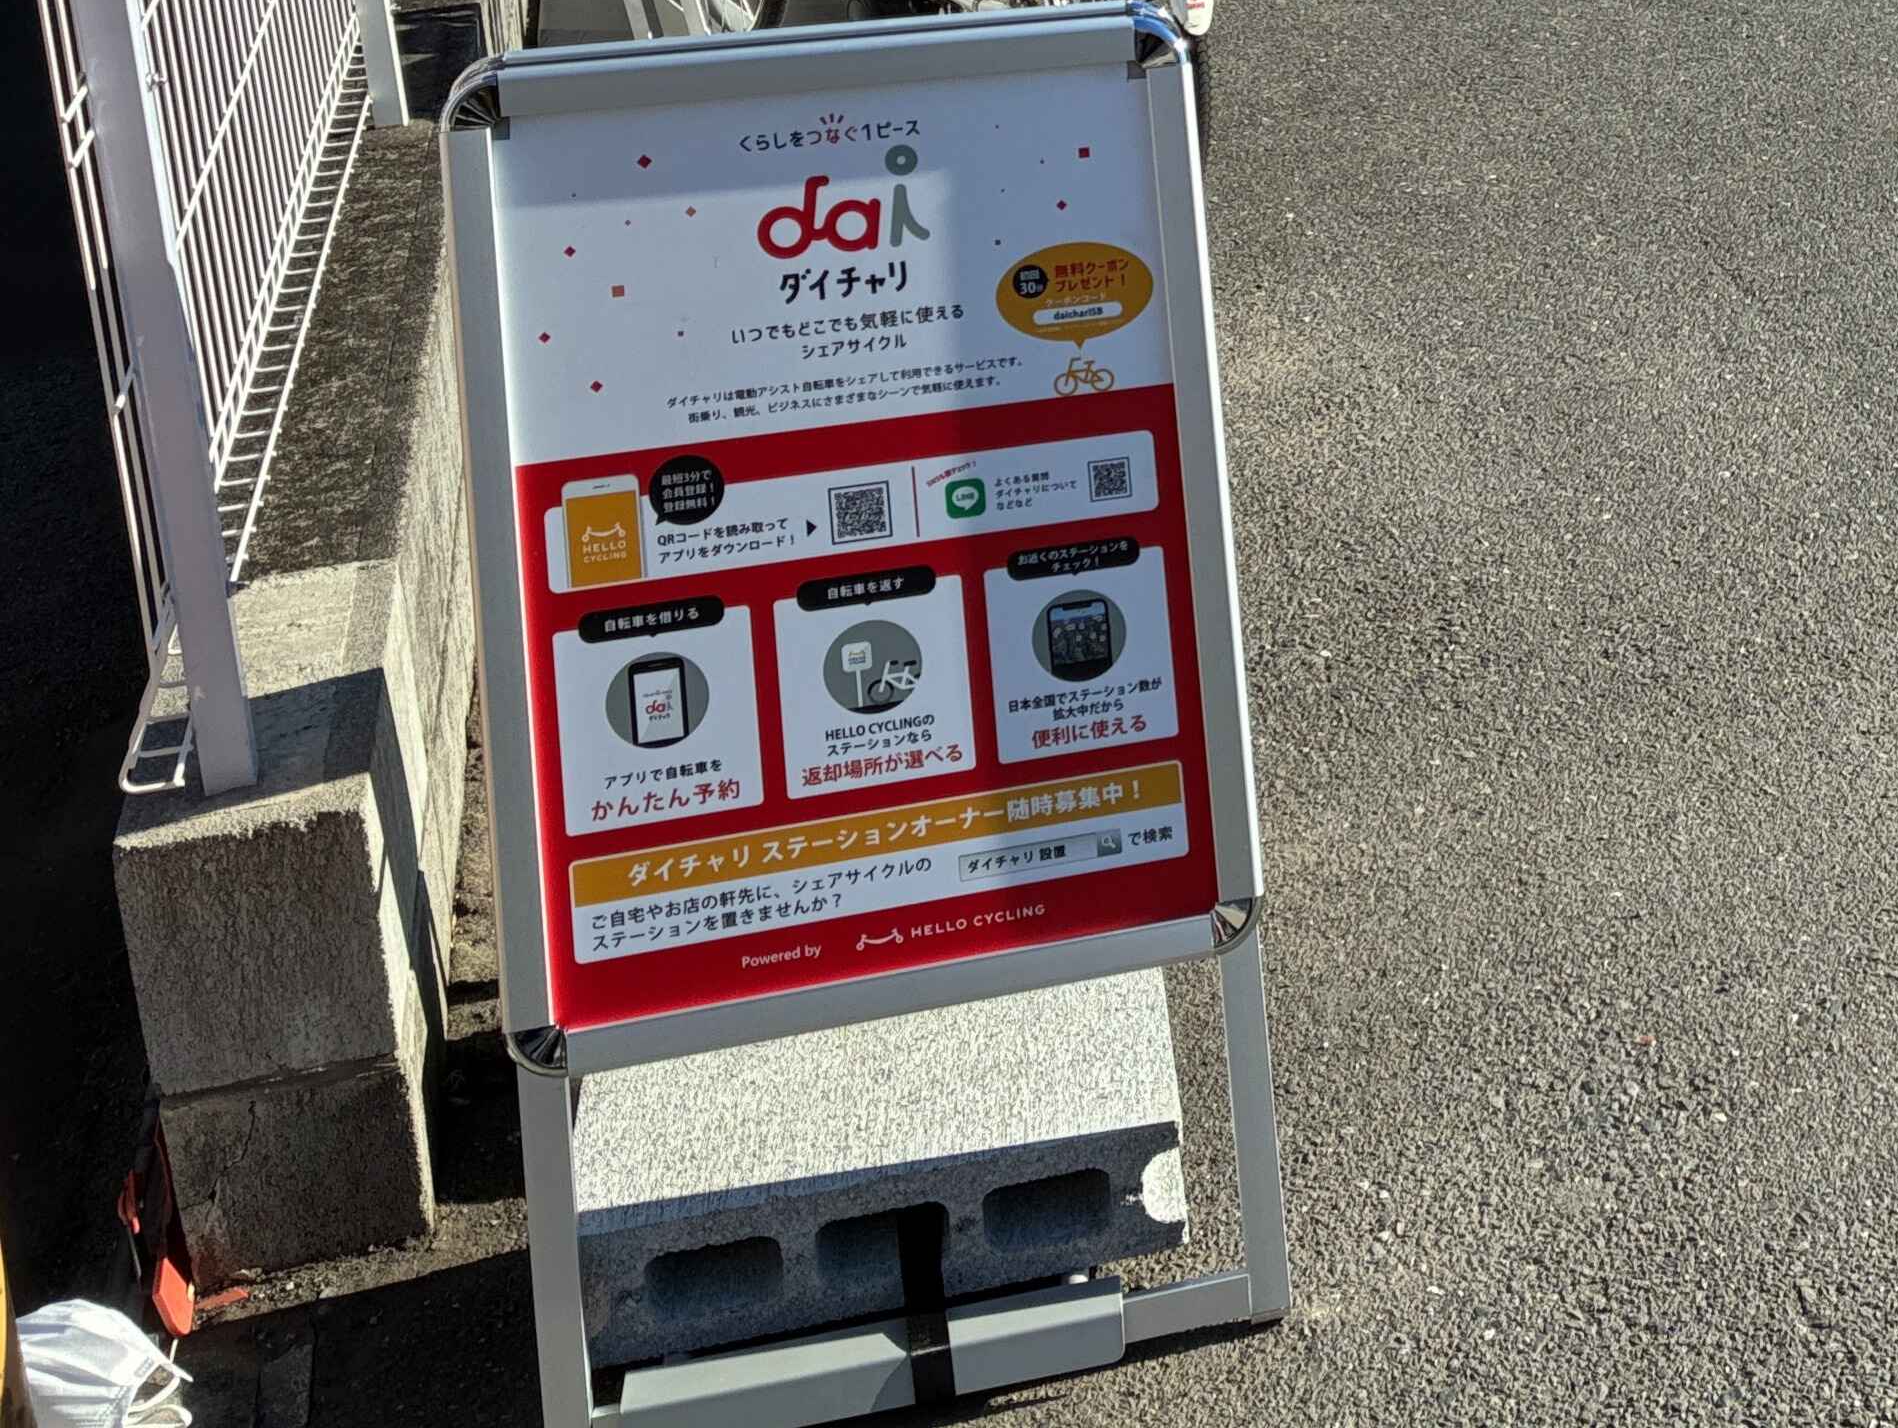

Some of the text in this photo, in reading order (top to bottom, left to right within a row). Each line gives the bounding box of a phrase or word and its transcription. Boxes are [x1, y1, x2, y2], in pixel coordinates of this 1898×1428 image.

[738, 118, 922, 153] くらしをつなぐ1ピース
[757, 144, 932, 260] dai
[779, 261, 909, 306] ダイチャリ
[1054, 259, 1129, 280] 無料クーポン
[730, 303, 965, 345] いつでもどこでも気軽に使える
[801, 334, 908, 360] シェアサイクル
[661, 470, 712, 486] 最短3分で
[994, 471, 1050, 488] よくある質問
[995, 480, 1078, 500] ダイチャリについて
[996, 498, 1034, 512] などなど
[657, 518, 789, 547] QRコードを読み取って
[581, 538, 628, 557] HELLO
[583, 551, 628, 565] CYCLING
[658, 534, 796, 565] アプリをダウンロード！
[1016, 538, 1130, 566] お近くのステーションを
[826, 575, 906, 601] 自転車を返す
[603, 604, 700, 634] 自転車を借りる
[1007, 677, 1162, 716] 日本全国でステーション数が
[1051, 698, 1126, 721] 拡大中だから
[824, 714, 936, 743] HELLO CYCLINGの
[1031, 715, 1148, 750] 便利に使える
[826, 729, 934, 758] ステーションなら
[603, 758, 723, 791] アプリで自転車を
[800, 743, 966, 789] 返却場所が選べる
[590, 778, 742, 824] かんたん予約
[1127, 826, 1174, 847] で検索
[627, 843, 751, 887] ダイチャリ
[966, 843, 1068, 874] ダイチャリ 設置
[590, 856, 933, 931] ご自宅やお店の軒先に、シェアサイクルの
[591, 892, 844, 952] ステーションを置きませんか？
[911, 903, 1046, 938] HELLO CYCLING
[741, 941, 822, 969] Powered by
